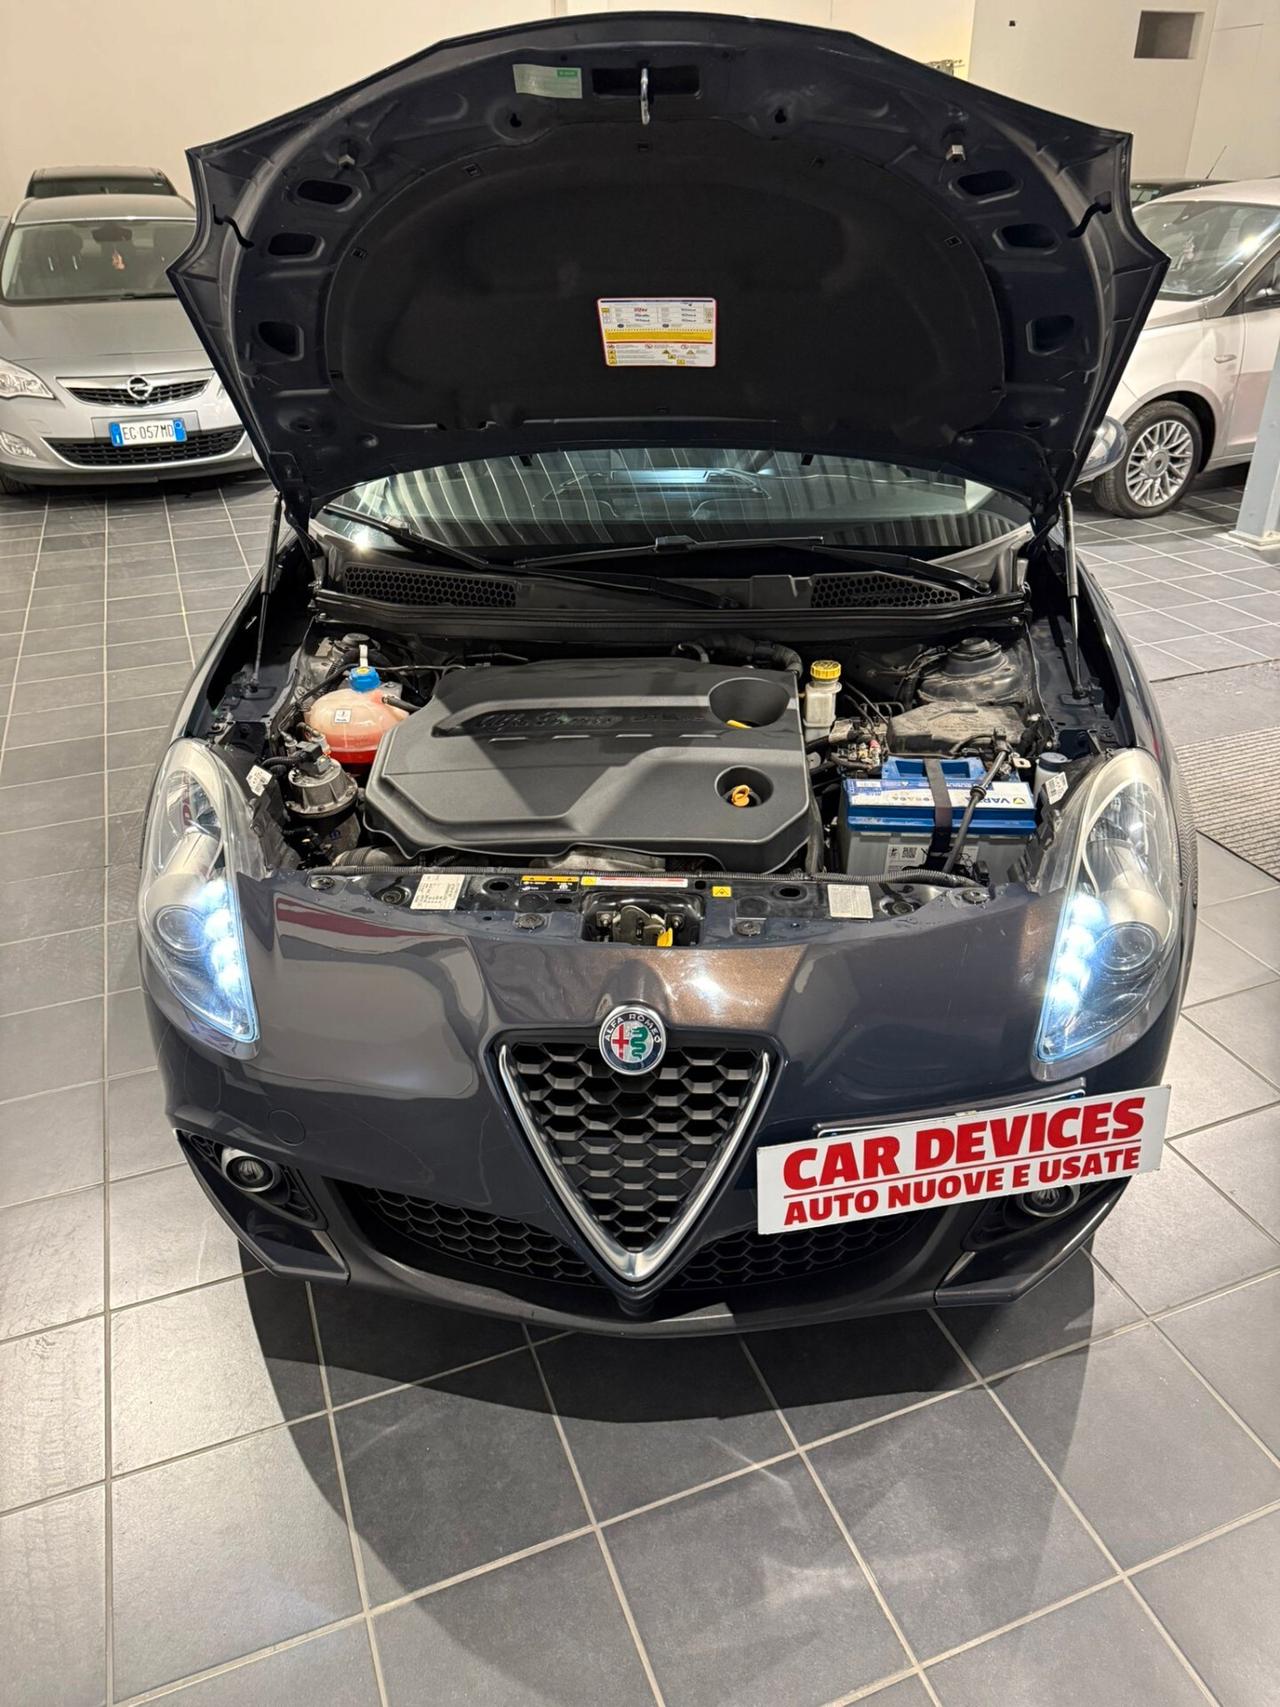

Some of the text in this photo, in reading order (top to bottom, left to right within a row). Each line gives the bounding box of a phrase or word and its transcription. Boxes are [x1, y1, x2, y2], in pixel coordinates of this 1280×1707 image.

[604, 1013, 662, 1043] ALFA ROMEO
[783, 1097, 1146, 1189] CAR DEVICES
[784, 1146, 1141, 1226] AUTO NUOVE E USATE
